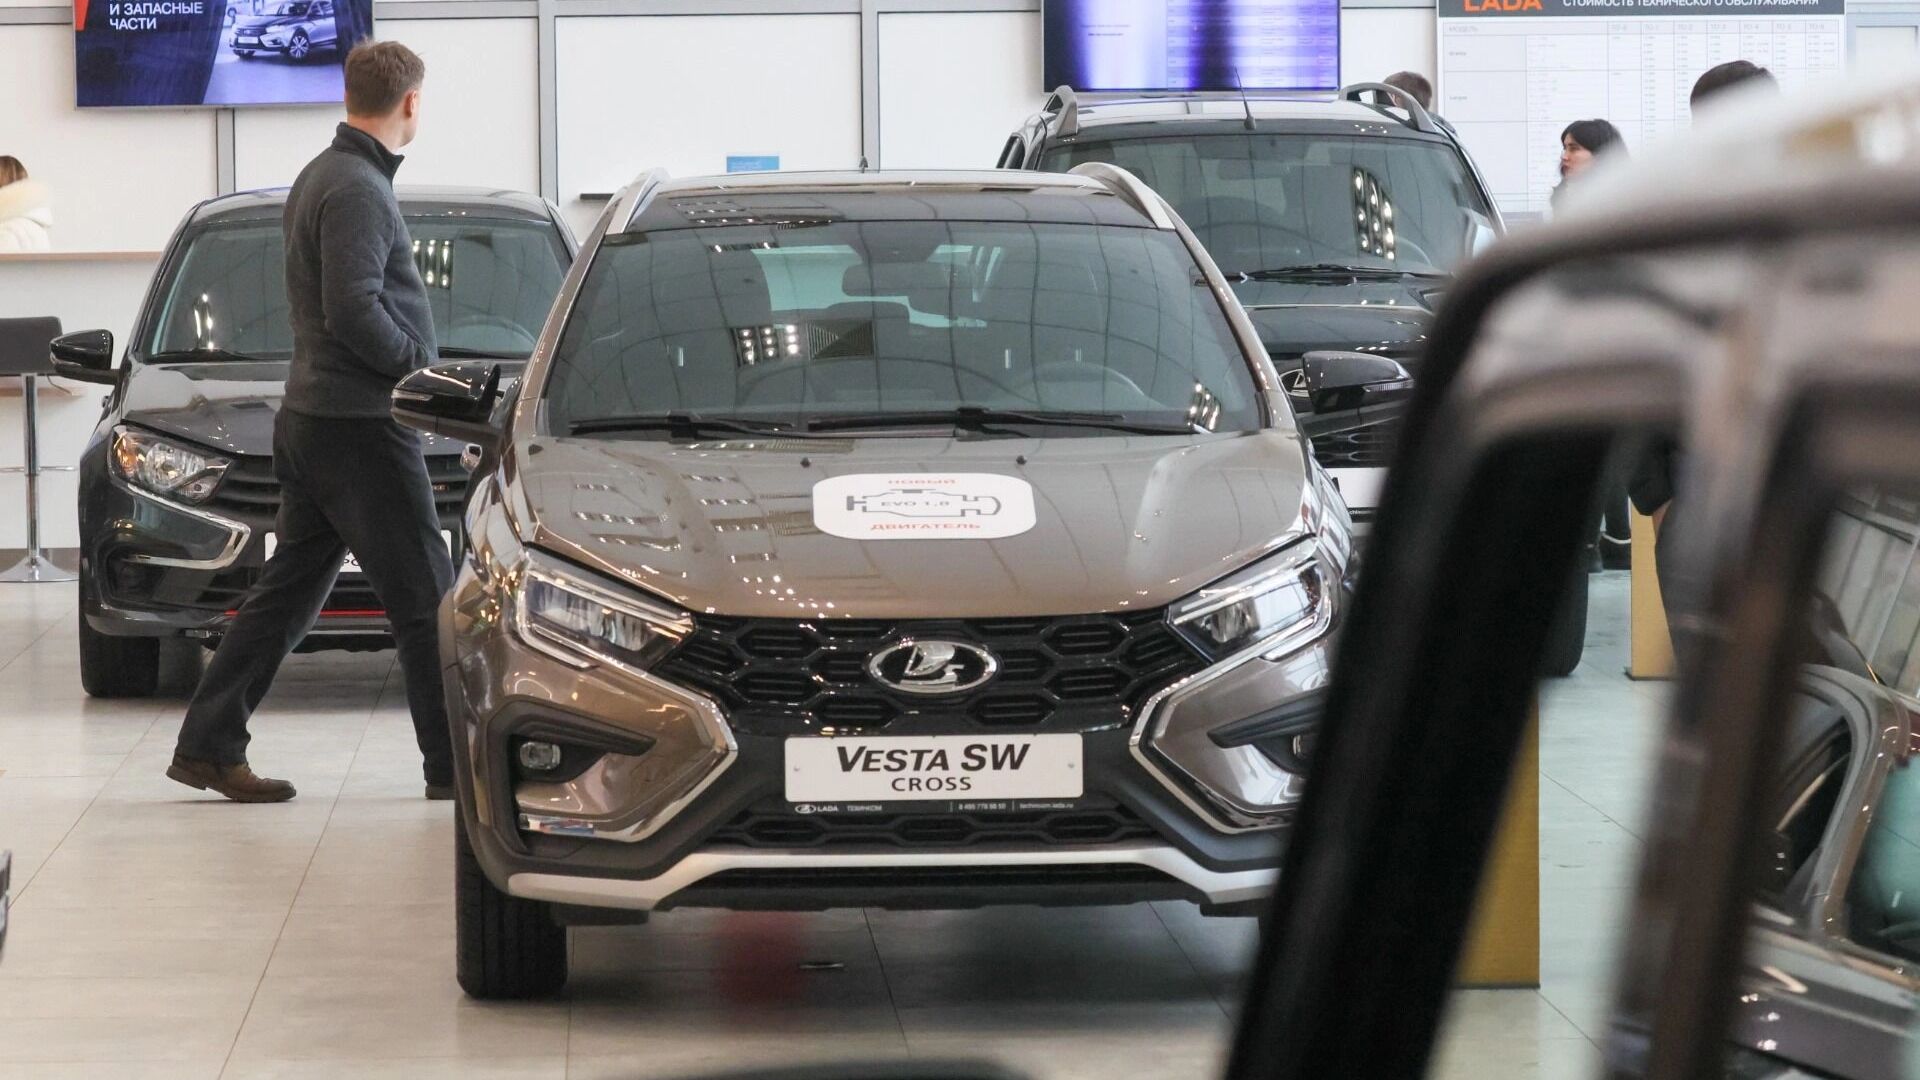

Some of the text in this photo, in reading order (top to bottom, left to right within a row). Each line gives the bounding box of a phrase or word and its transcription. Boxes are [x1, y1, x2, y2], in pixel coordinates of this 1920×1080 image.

[109, 2, 204, 15] И ЗАПАСНЫЕ
[1464, 0, 1543, 12] LADA
[109, 17, 157, 30] ЧАСТИ
[870, 523, 981, 531] ДВИГАТЕЛЬ
[836, 743, 1031, 772] VESTA SW
[891, 776, 972, 792] CROSS
[817, 804, 839, 812] LADA
